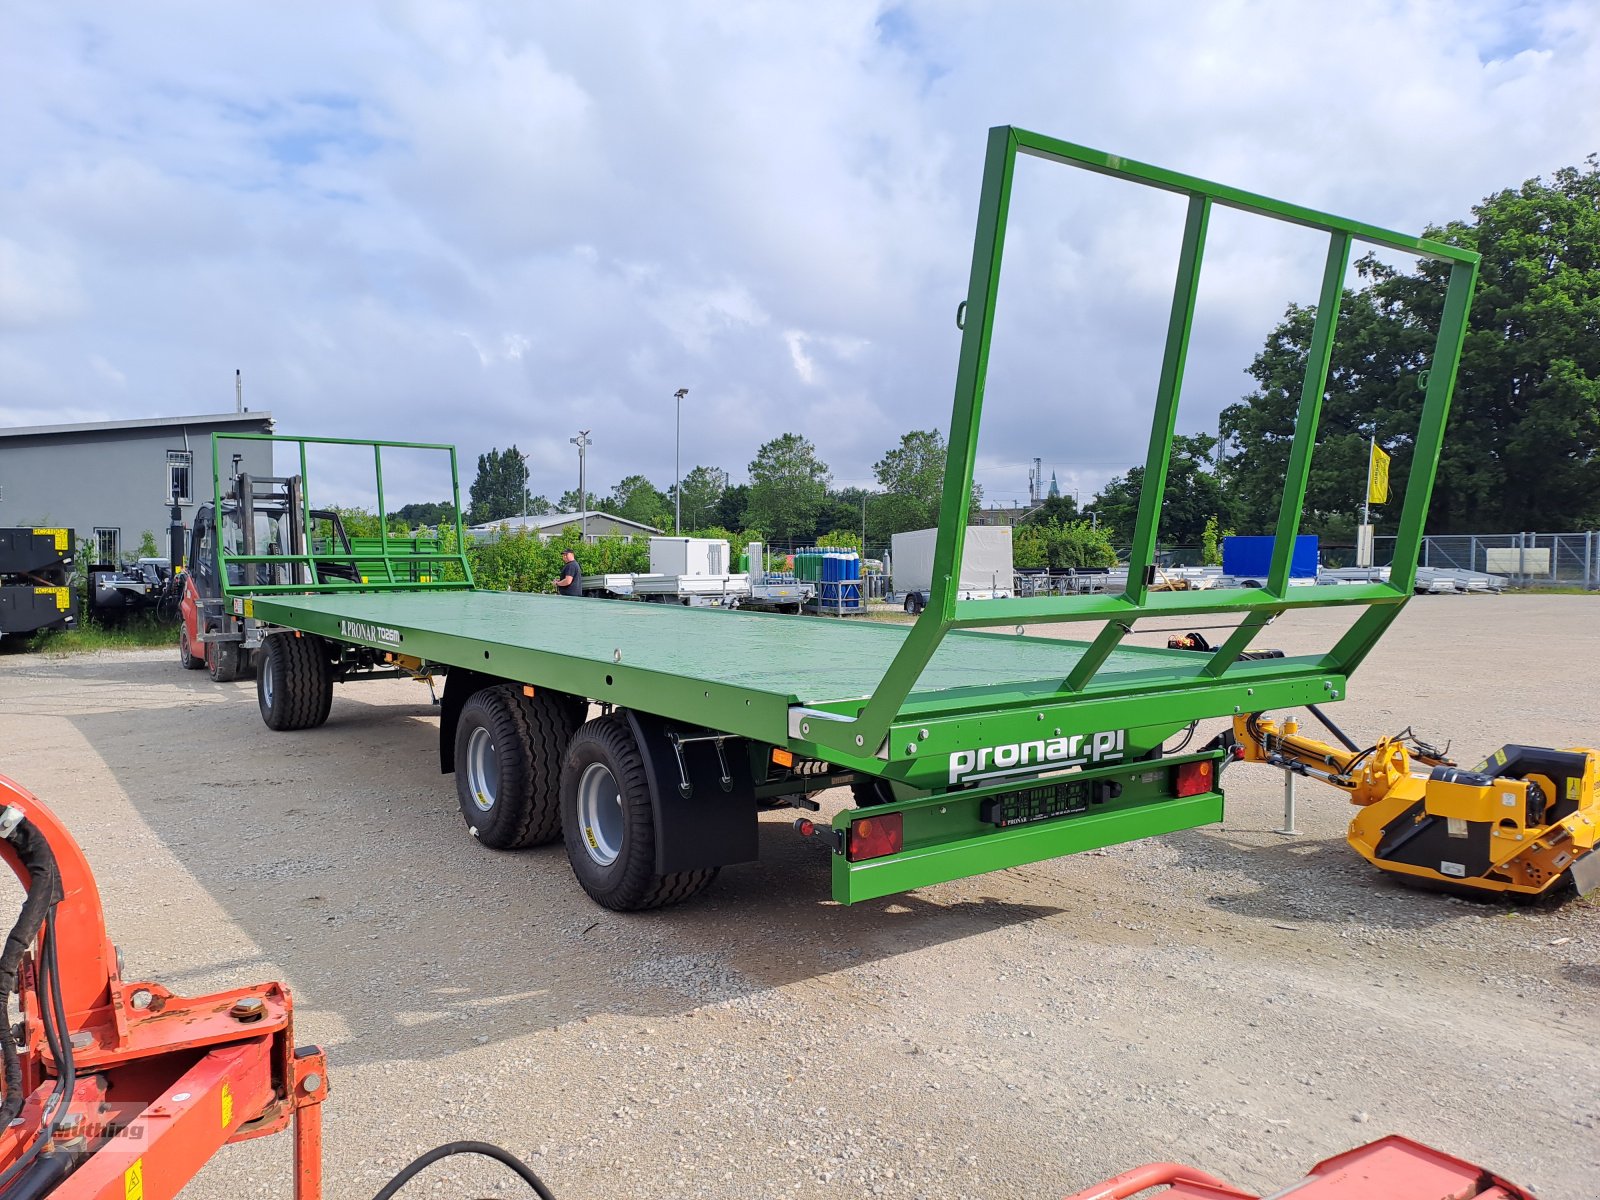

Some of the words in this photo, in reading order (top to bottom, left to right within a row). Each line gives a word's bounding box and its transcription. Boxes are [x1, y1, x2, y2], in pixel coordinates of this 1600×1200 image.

[347, 621, 376, 642] PRONAR
[949, 729, 1125, 784] pronar.pl
[1007, 816, 1027, 826] PRONAR
